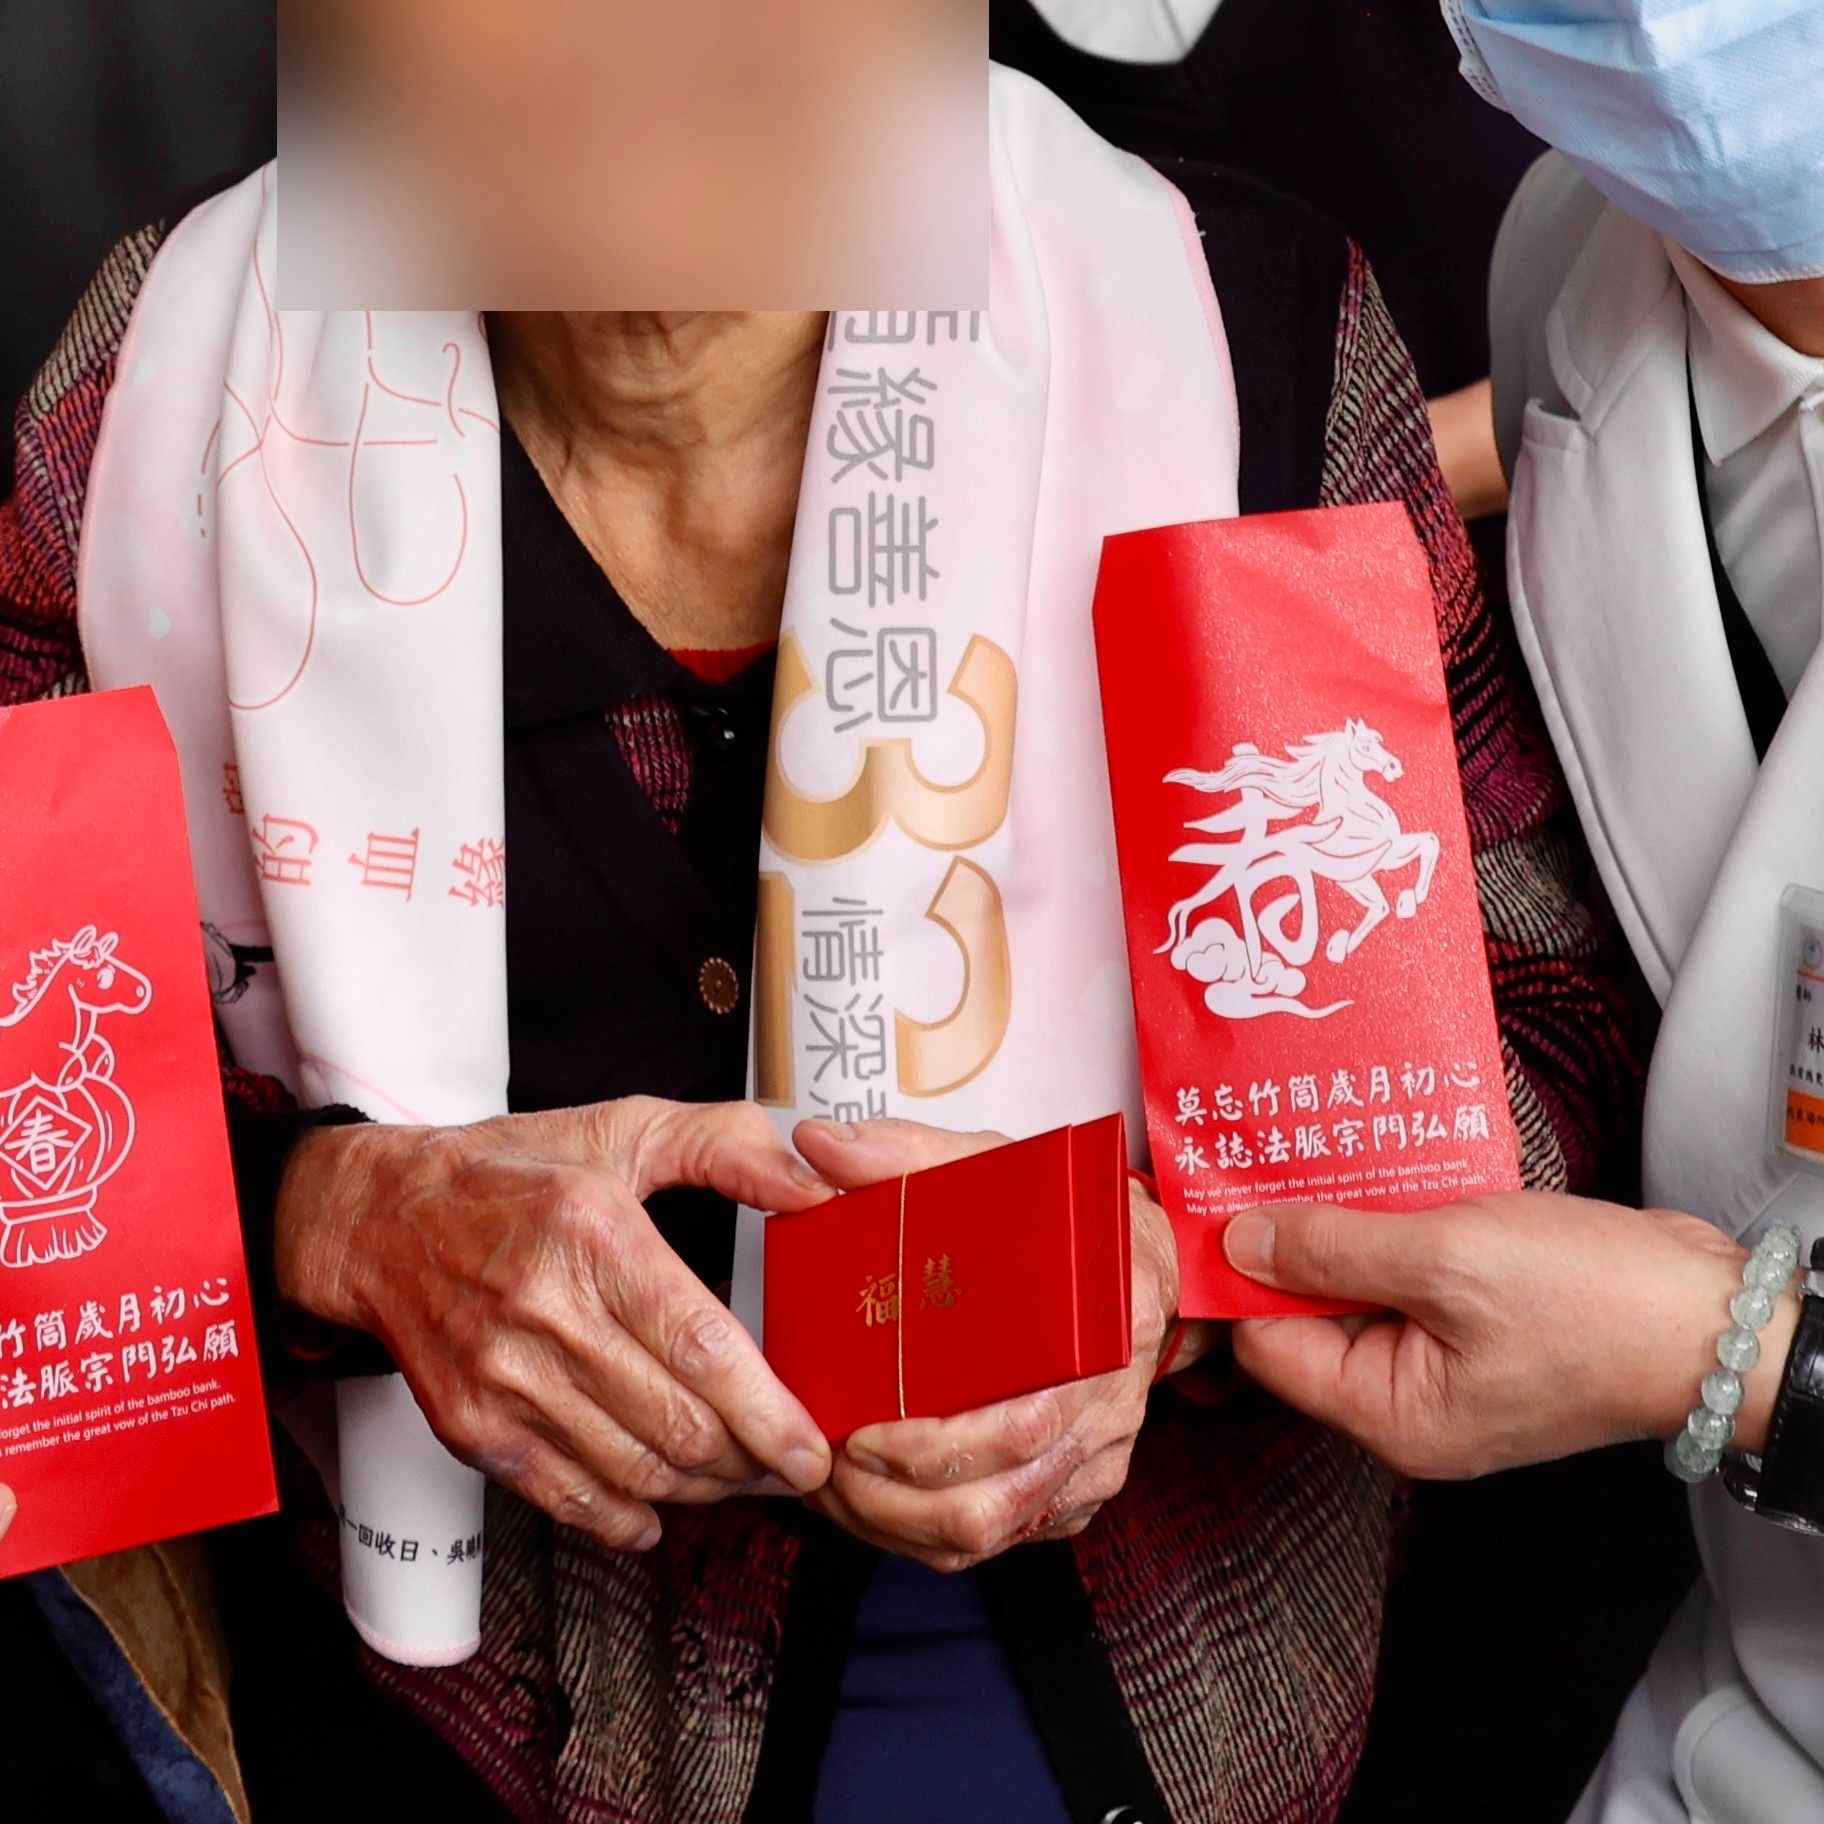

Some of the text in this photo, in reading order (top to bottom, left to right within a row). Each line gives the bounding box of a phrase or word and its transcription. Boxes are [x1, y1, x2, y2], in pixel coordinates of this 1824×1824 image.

[1174, 1061, 1481, 1126] 莫忘竹筒歲月初心
[4, 1107, 74, 1174] 春
[1174, 1103, 1490, 1176] 永誌法脈宗門弘願
[1183, 1188, 1205, 1200] May
[1207, 1188, 1222, 1198] we
[1224, 1184, 1252, 1196] never
[1255, 1179, 1286, 1194] forget
[1288, 1177, 1305, 1189] the
[1307, 1173, 1336, 1187] initial
[1338, 1171, 1363, 1185] spirit
[1365, 1169, 1376, 1180] of
[1378, 1167, 1396, 1178] the
[1398, 1162, 1442, 1177] bamboo
[1186, 1204, 1207, 1216] May
[1209, 1204, 1224, 1214] we
[1317, 1190, 1334, 1202] the
[1336, 1188, 1363, 1203] great
[1365, 1185, 1386, 1196] vow
[1388, 1183, 1399, 1194] of
[1402, 1181, 1419, 1192] the
[1421, 1179, 1439, 1190] Tzu
[5, 1434, 60, 1457] remember
[63, 1429, 81, 1443] the
[83, 1423, 112, 1441] great
[114, 1418, 136, 1431] vow
[138, 1412, 149, 1426] of
[151, 1409, 169, 1423] the
[170, 1405, 189, 1418] Tzu
[190, 1399, 208, 1413] Chi
[210, 1392, 236, 1411] path.
[32, 1419, 51, 1432] the
[53, 1410, 82, 1427] initial
[85, 1406, 112, 1423] spirit
[114, 1402, 125, 1414] of
[127, 1397, 145, 1411] the
[147, 1387, 191, 1406] bamboo
[193, 1378, 222, 1394] bank.
